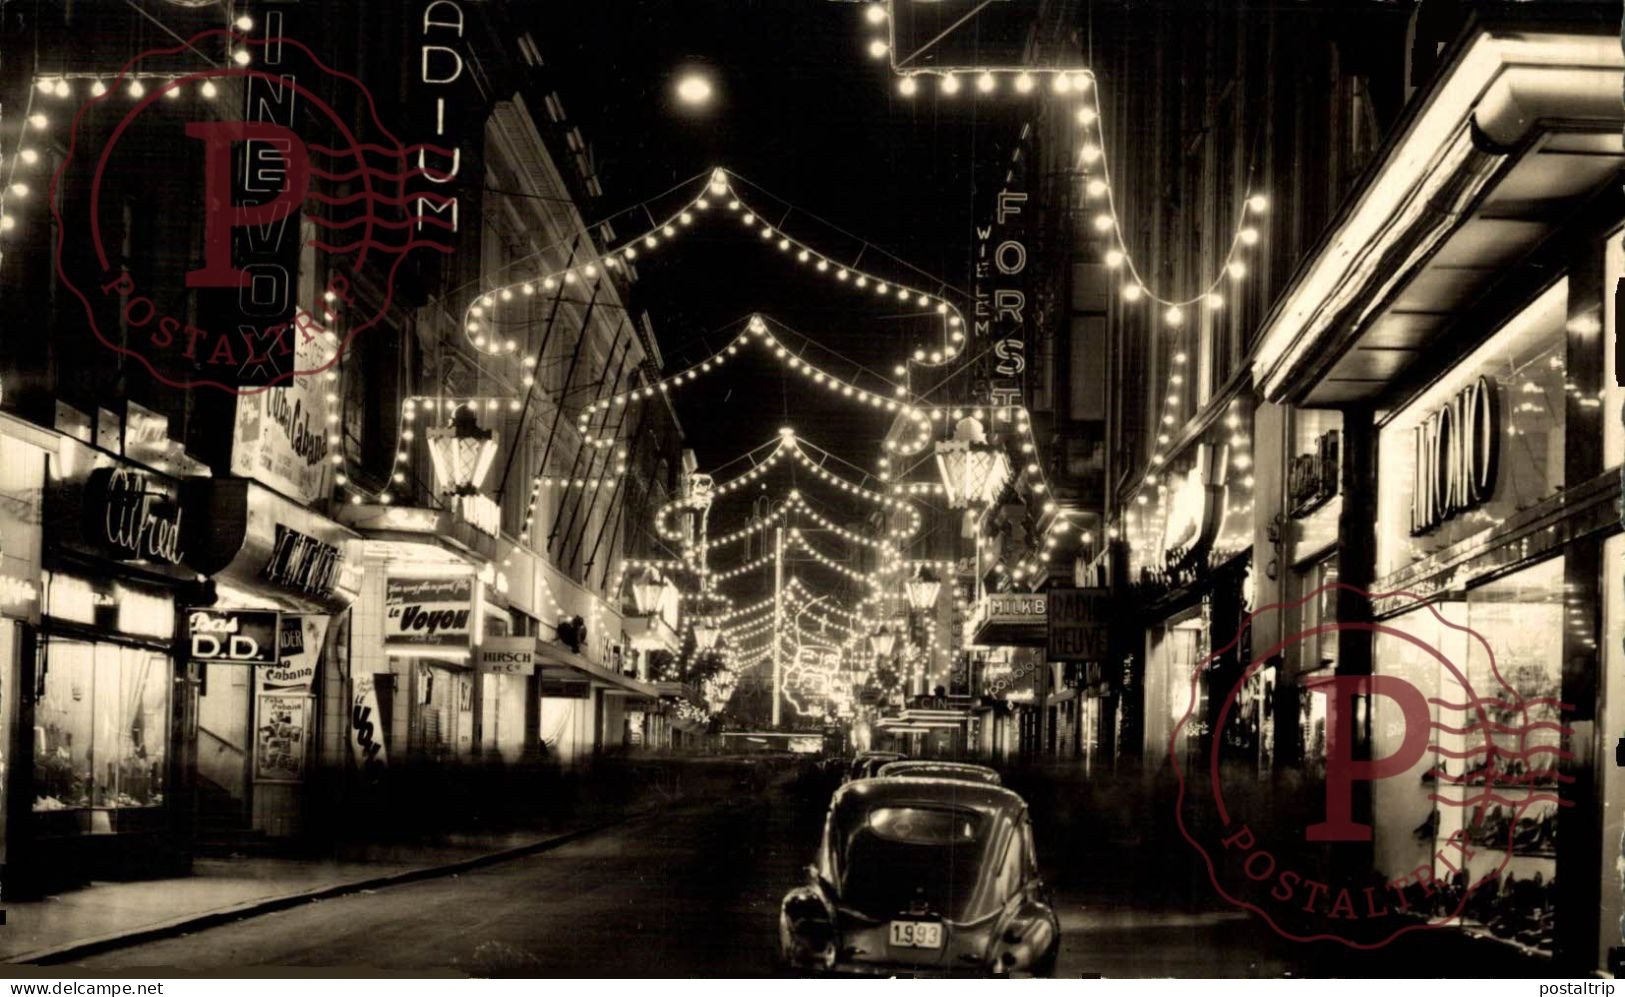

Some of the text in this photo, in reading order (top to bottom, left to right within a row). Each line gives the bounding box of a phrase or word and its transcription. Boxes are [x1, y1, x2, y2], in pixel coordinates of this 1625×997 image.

[993, 192, 1028, 423] FORST
[106, 470, 184, 565] Alfred
[388, 605, 471, 634] Le Voyou
[1052, 595, 1105, 622] RADI
[191, 634, 264, 660] D.D.
[483, 651, 531, 663] HIRSCH
